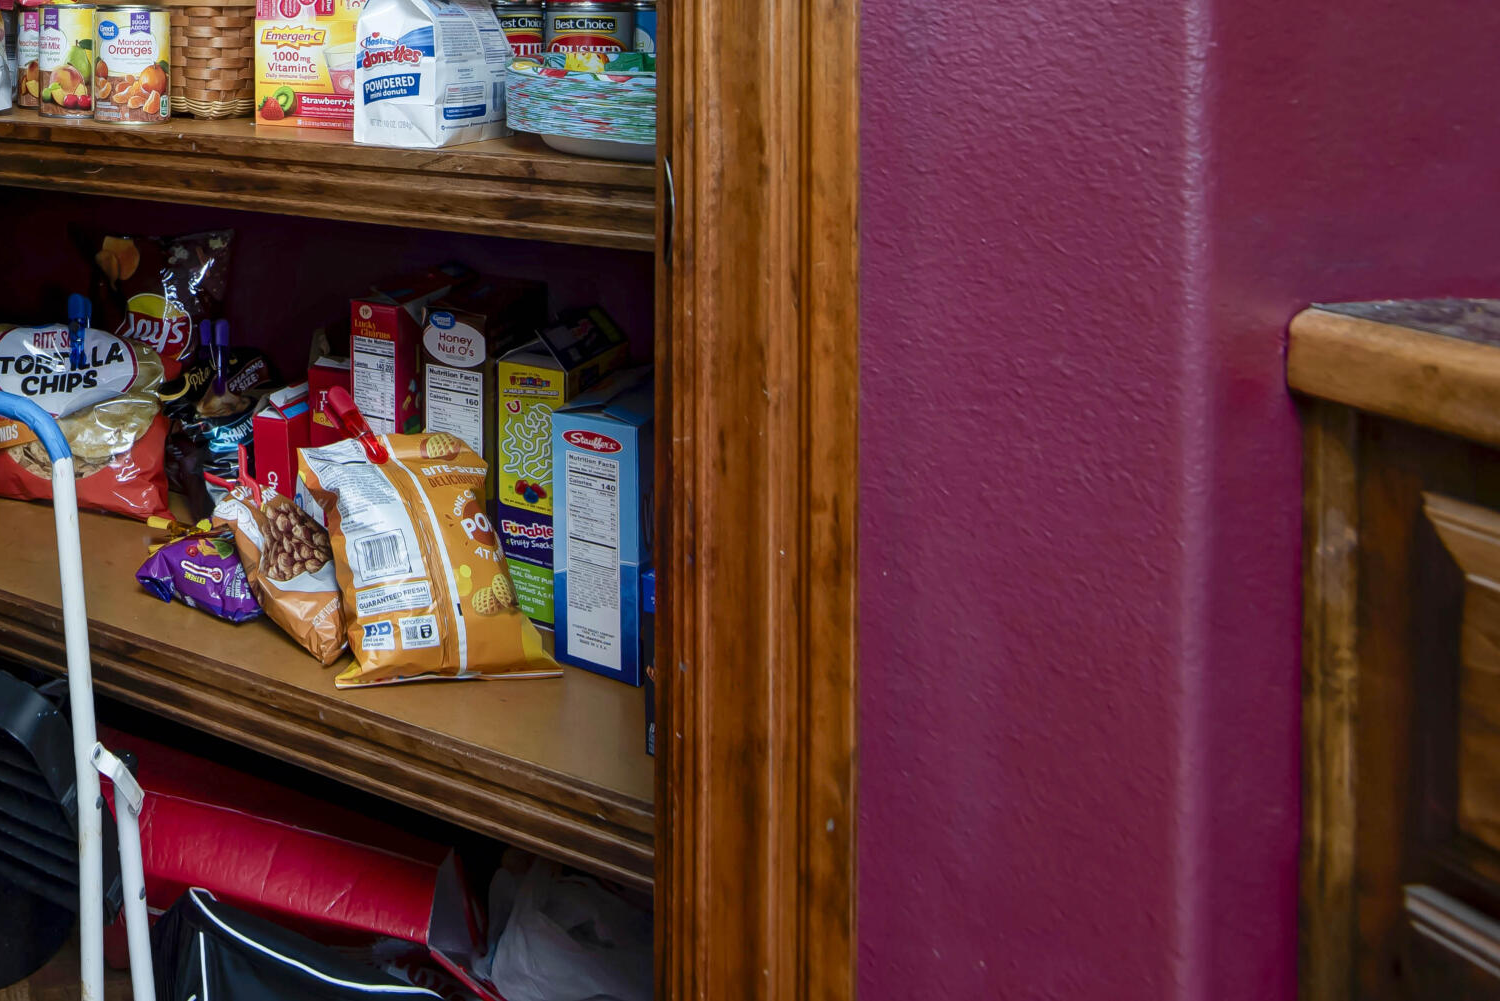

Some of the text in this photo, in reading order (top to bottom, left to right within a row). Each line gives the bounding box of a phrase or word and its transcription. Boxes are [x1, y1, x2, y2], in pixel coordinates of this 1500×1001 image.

[501, 18, 517, 28] est
[555, 18, 615, 31] Best Choice
[117, 38, 153, 46] Mandarin
[265, 31, 323, 44] Emergen-C
[364, 37, 397, 47] Hostess
[48, 42, 61, 50] Mix
[108, 44, 153, 57] Oranges
[300, 56, 311, 64] mg
[362, 44, 422, 69] donettes
[267, 62, 317, 73] Vitamin C
[364, 75, 416, 94] POWDERED
[369, 87, 408, 100] mini donuts
[301, 95, 356, 107] Strawberry-K
[354, 319, 377, 331] Lucky
[122, 312, 187, 354] Lay's
[360, 328, 391, 340] Charms
[439, 331, 473, 347] Honey
[32, 331, 58, 350] BITE
[438, 342, 456, 354] Nut
[189, 366, 211, 391] Pita
[228, 360, 265, 392] SHARING
[429, 367, 480, 383] Nutrition Facts
[20, 369, 98, 396] CHIPS
[237, 374, 260, 392] SIZE
[429, 391, 480, 407] Calories 160
[570, 432, 617, 450] Stauffer's
[568, 454, 617, 469] Nutrition Facts
[420, 464, 488, 477] BITE-SIZE
[568, 477, 617, 492] Calories 140
[453, 495, 466, 517] ONE
[501, 519, 554, 540] Funable
[510, 539, 554, 550] Fruity Snacks
[474, 546, 491, 560] AT
[358, 586, 427, 610] GUARANTEED FRESH
